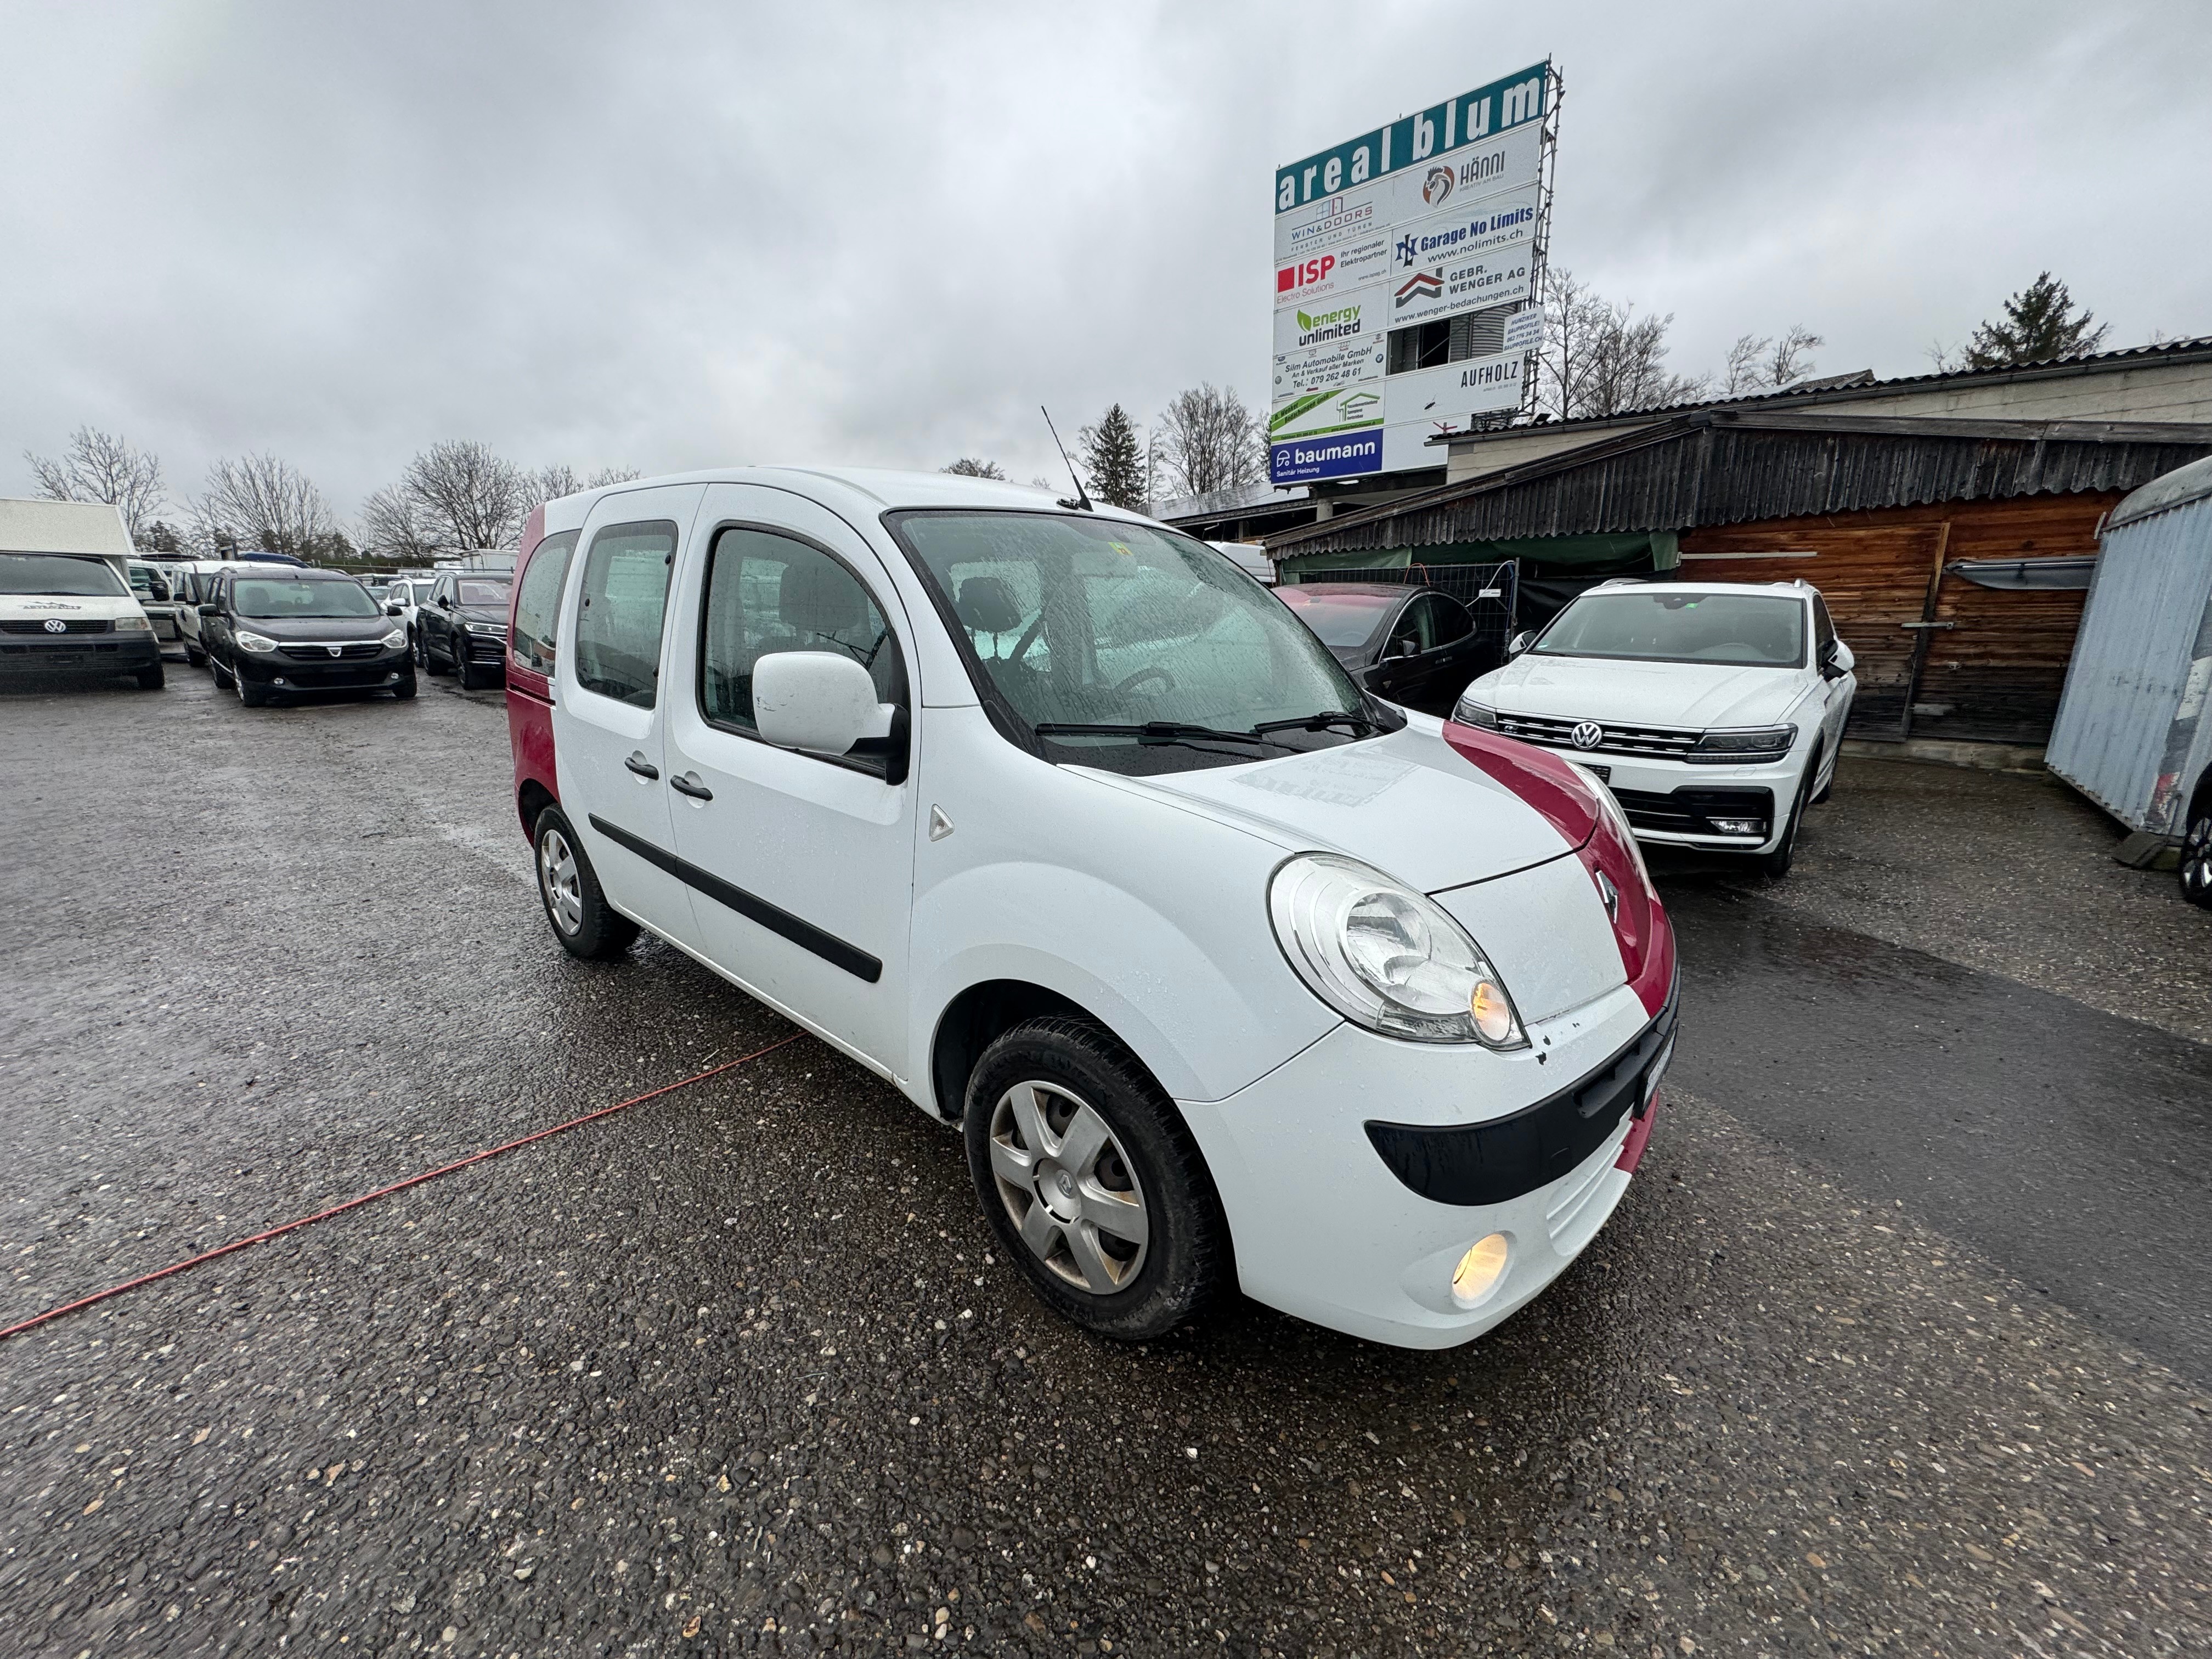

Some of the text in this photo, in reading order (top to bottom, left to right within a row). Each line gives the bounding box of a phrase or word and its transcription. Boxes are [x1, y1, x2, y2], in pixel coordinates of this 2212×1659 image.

[1279, 77, 1540, 210] areal blum
[1460, 151, 1505, 185] HÄNNI
[1460, 182, 1481, 192] KREATIV
[1291, 206, 1373, 240] WIN&DOORS
[1421, 207, 1533, 252] Garage No Limits
[1291, 238, 1323, 252] FENSTER
[1328, 232, 1342, 240] UND
[1348, 222, 1372, 234] TÜREN
[1351, 239, 1385, 255] regionaler
[1427, 229, 1523, 263] www.nolimits.ch
[1298, 255, 1335, 287] ISP
[1340, 249, 1387, 268] Elektropartner
[1449, 267, 1526, 295] WENGER AG
[1450, 265, 1487, 281] GEBR.
[1277, 282, 1334, 304] Electro Solutions
[1395, 285, 1524, 323] www.wenger-bedachungen.ch
[1313, 304, 1361, 328] energy
[1299, 318, 1361, 346] unlimited
[1302, 352, 1345, 369] Automobile
[1347, 346, 1373, 359] GmbH
[1307, 364, 1328, 376] Verkauf
[1329, 363, 1341, 371] aller
[1342, 358, 1364, 368] Marken
[1311, 375, 1324, 385] 079
[1325, 371, 1339, 381] 262
[1341, 369, 1350, 379] 48
[1352, 367, 1362, 376] 61
[1461, 361, 1519, 388] AUFHOLZ
[1295, 442, 1375, 465] baumann
[1277, 467, 1320, 477] Sanitär Heizung
